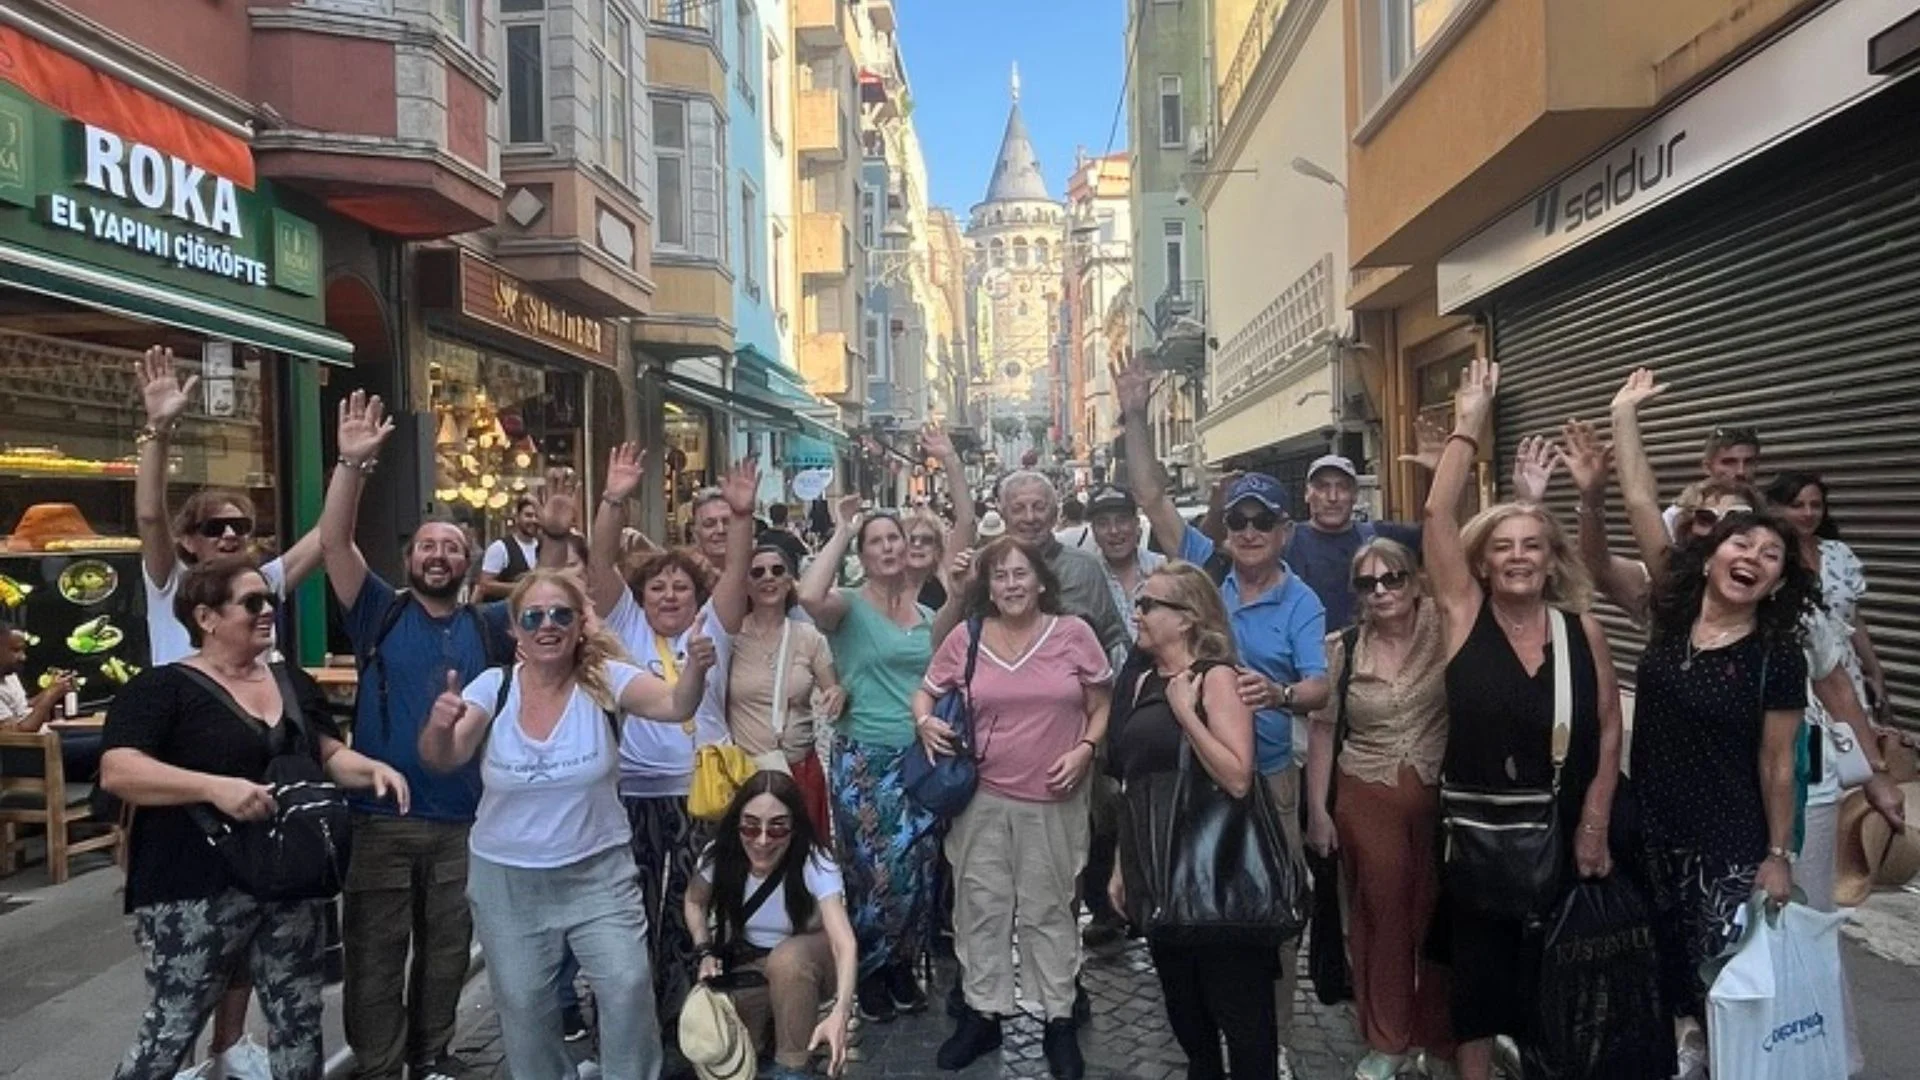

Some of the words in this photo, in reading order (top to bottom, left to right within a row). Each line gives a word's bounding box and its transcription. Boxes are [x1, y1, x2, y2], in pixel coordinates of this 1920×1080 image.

[84, 124, 243, 238] ROKA
[1564, 130, 1687, 234] seldur
[51, 194, 86, 231] EL
[89, 206, 169, 258] YAPIMI
[174, 232, 268, 287] ÇİĞKÖFTE
